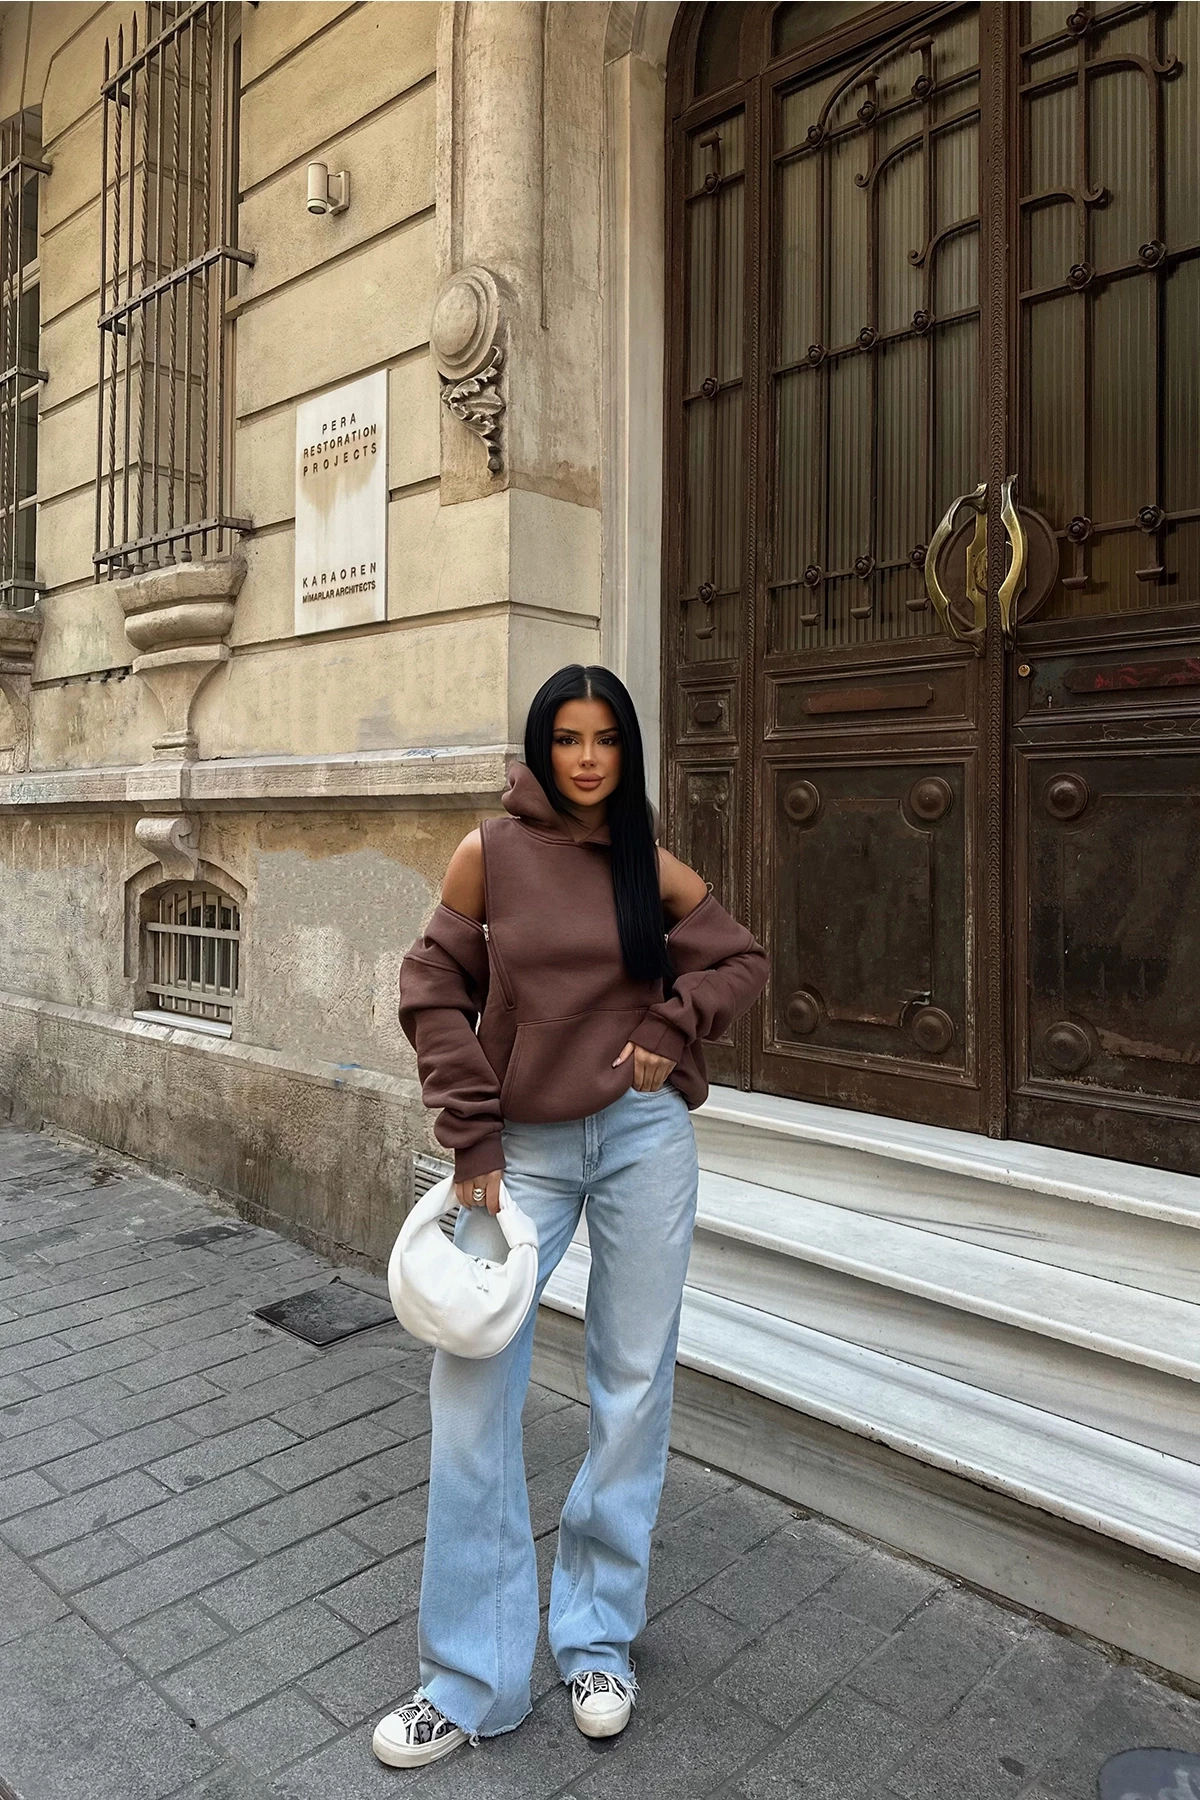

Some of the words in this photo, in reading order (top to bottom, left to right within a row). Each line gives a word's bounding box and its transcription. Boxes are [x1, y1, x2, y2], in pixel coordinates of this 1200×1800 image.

[322, 413, 356, 434] PERA
[303, 424, 377, 459] RESTORATION
[303, 442, 377, 477] PROJECTS
[302, 562, 377, 588] KARAOREN
[335, 580, 377, 597] ARCHITECTS
